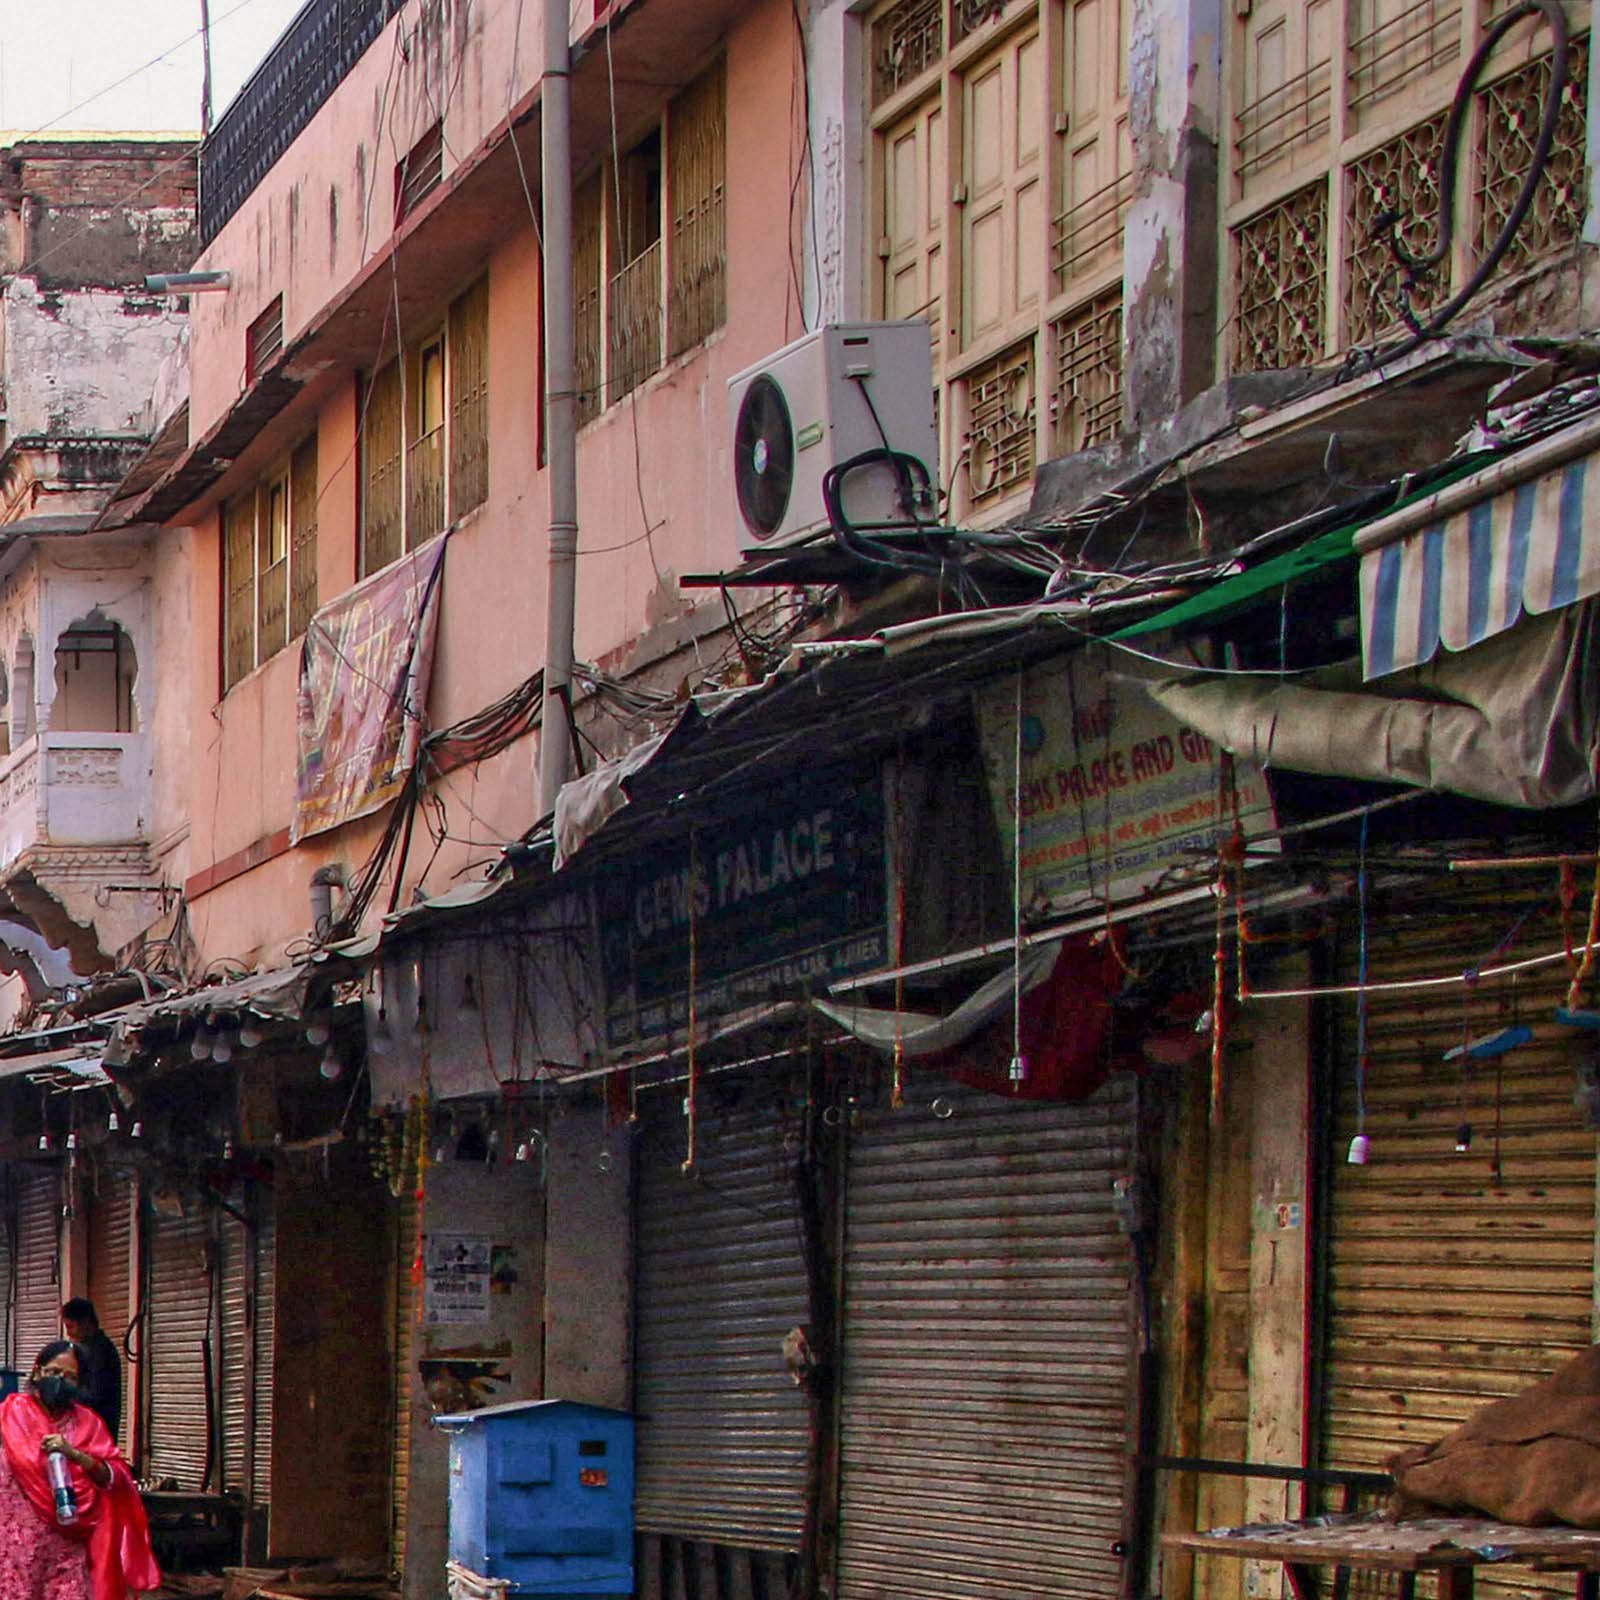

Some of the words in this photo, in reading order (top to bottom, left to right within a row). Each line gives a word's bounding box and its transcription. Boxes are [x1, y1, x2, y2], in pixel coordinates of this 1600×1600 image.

[1056, 751, 1129, 805] PALACE
[1132, 735, 1175, 783] AND
[636, 866, 711, 937] GEMS
[716, 810, 836, 908] PALACE
